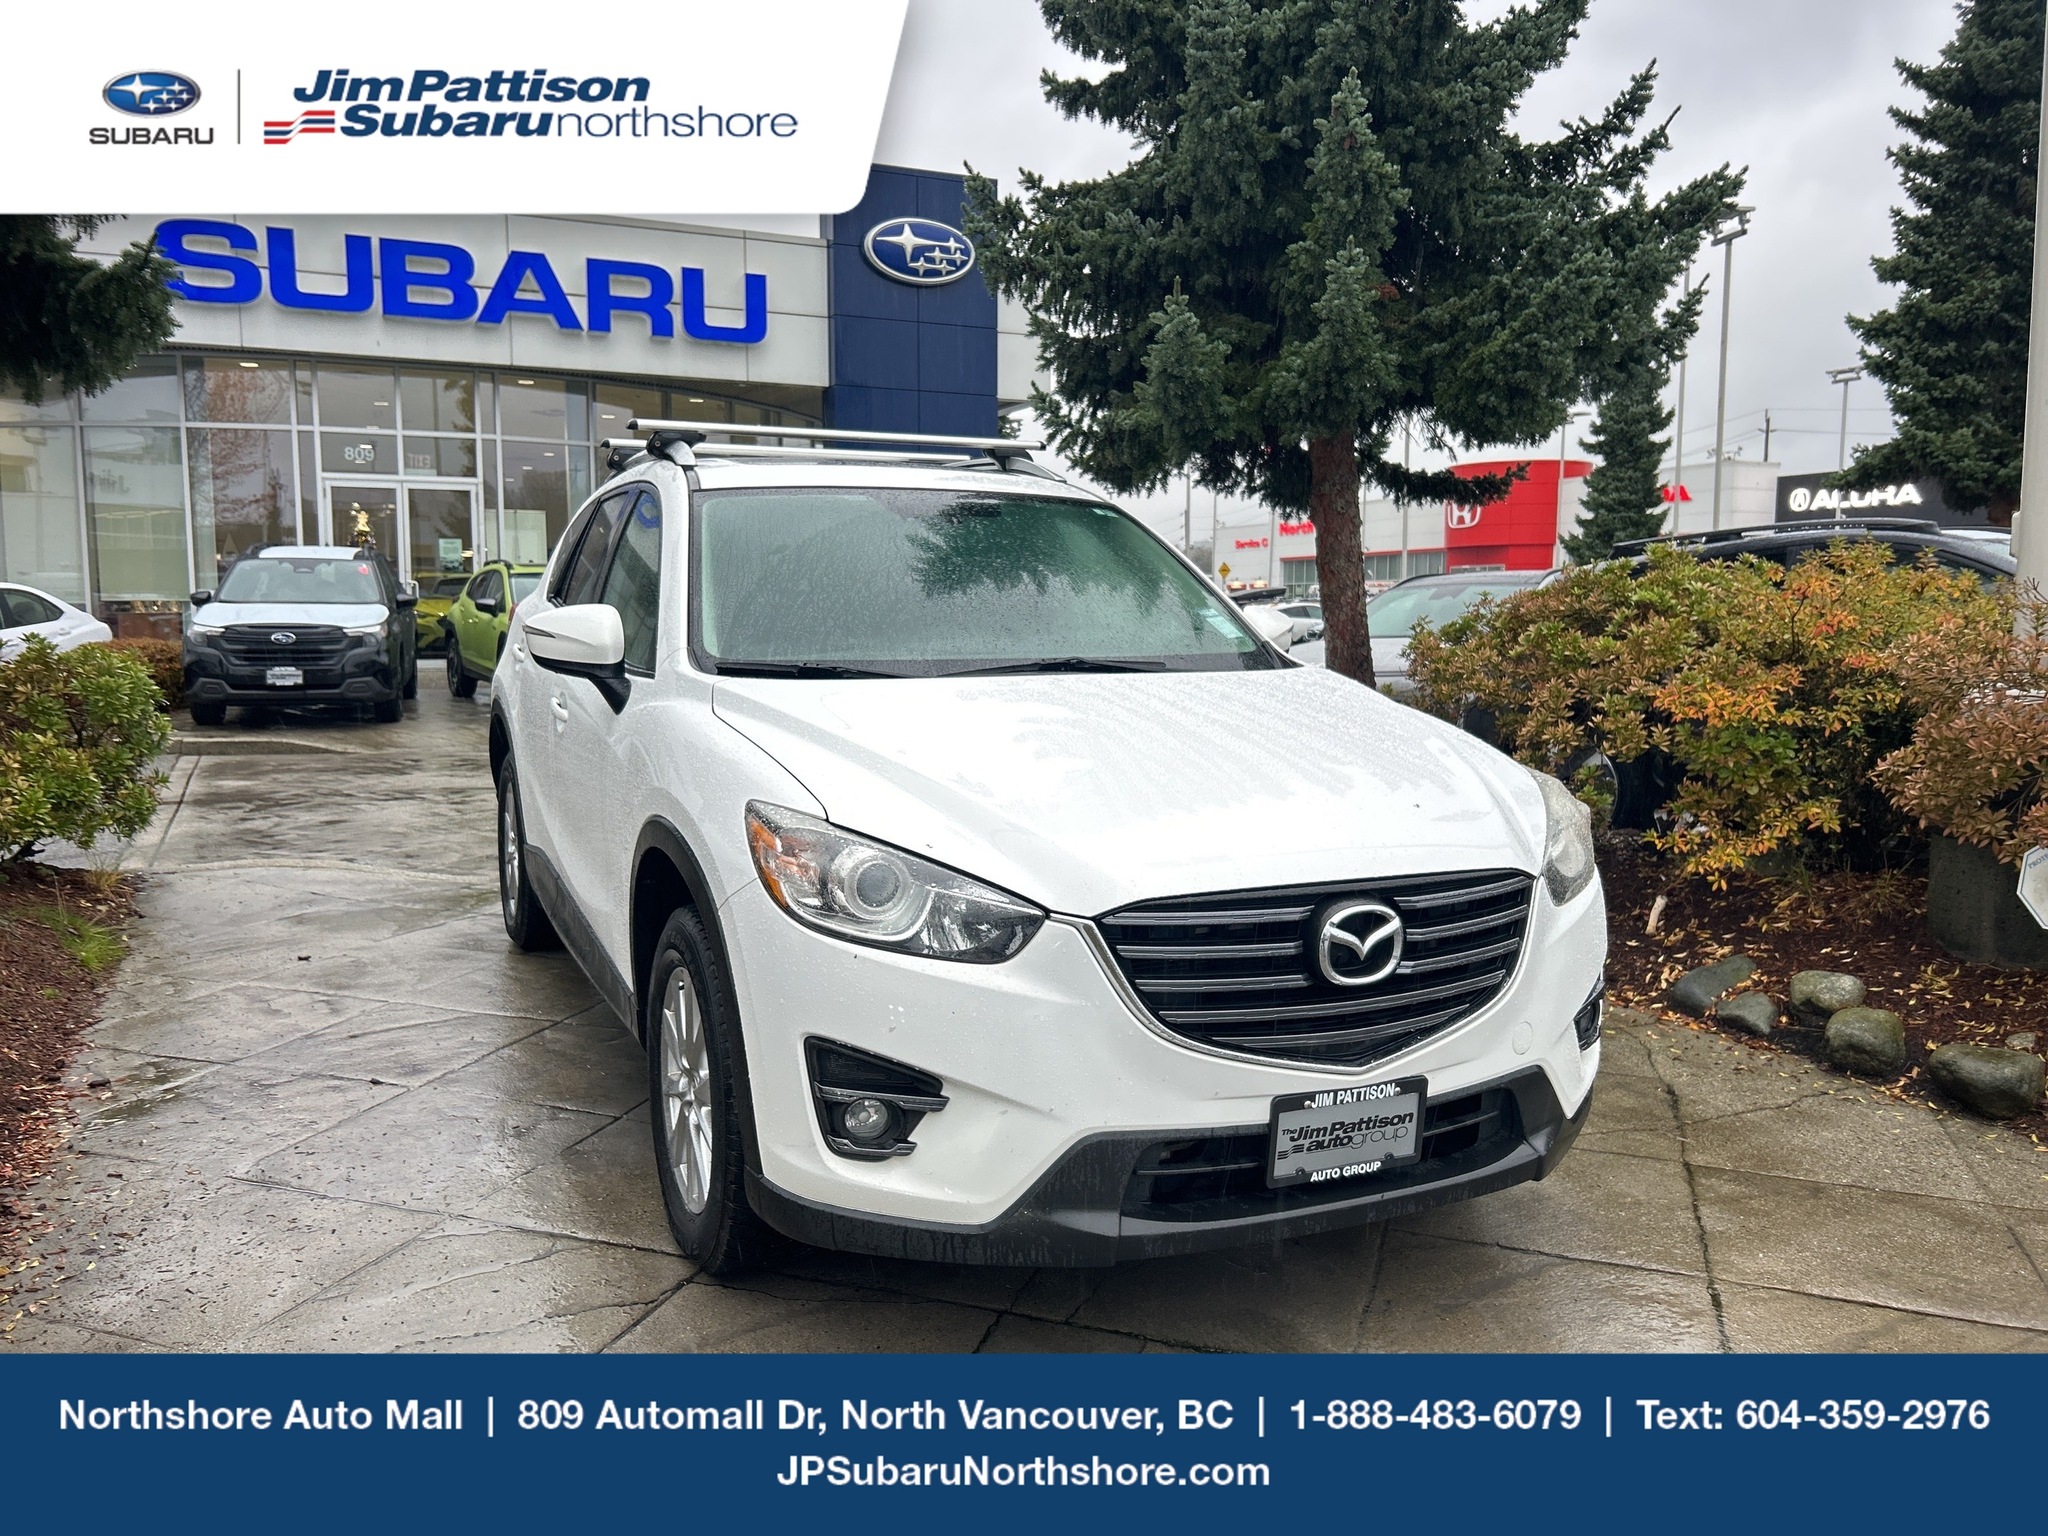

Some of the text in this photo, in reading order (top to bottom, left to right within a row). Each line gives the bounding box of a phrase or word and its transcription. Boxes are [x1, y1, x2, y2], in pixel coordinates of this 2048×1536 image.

[155, 218, 768, 346] SUBARU
[343, 445, 375, 462] 809
[1311, 1083, 1396, 1109] JIM PATTISON
[1281, 1112, 1414, 1142] The Jim Pattison
[1310, 1161, 1382, 1183] AUTO GROUP
